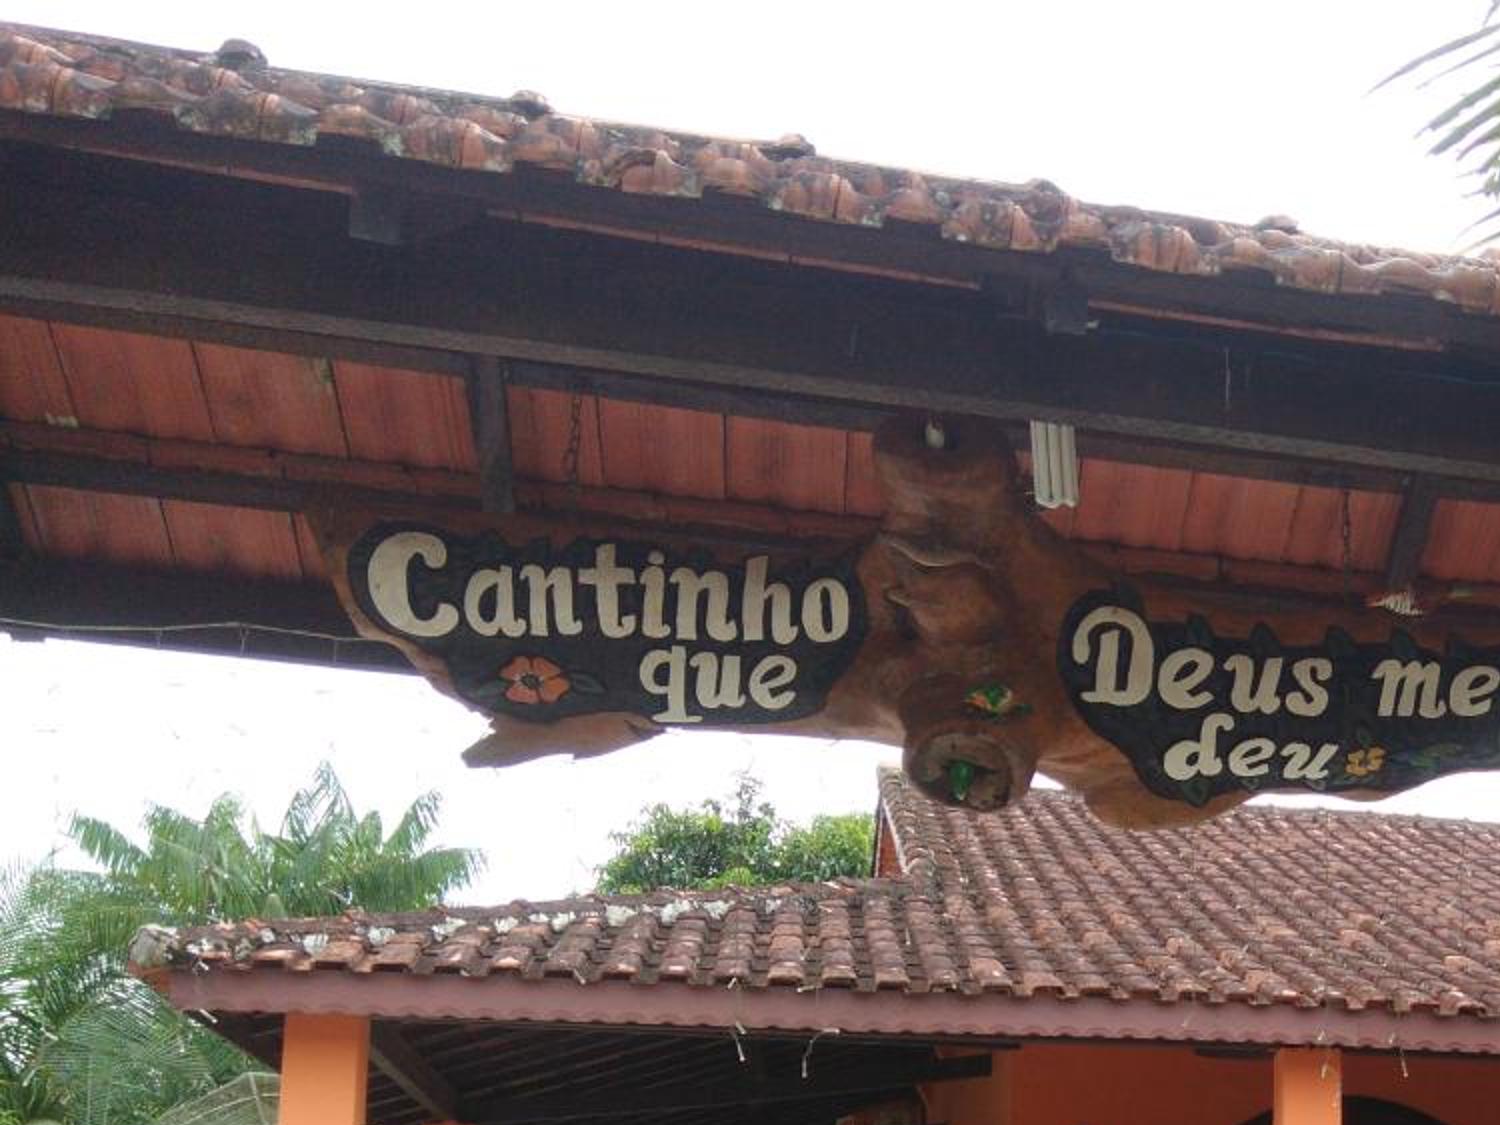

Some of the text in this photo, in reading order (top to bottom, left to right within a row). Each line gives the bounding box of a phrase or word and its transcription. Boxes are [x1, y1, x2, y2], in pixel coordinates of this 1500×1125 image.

[368, 531, 850, 644] Cantinho
[639, 645, 798, 723] que
[1072, 606, 1500, 718] Deus me
[1163, 713, 1340, 781] deu
